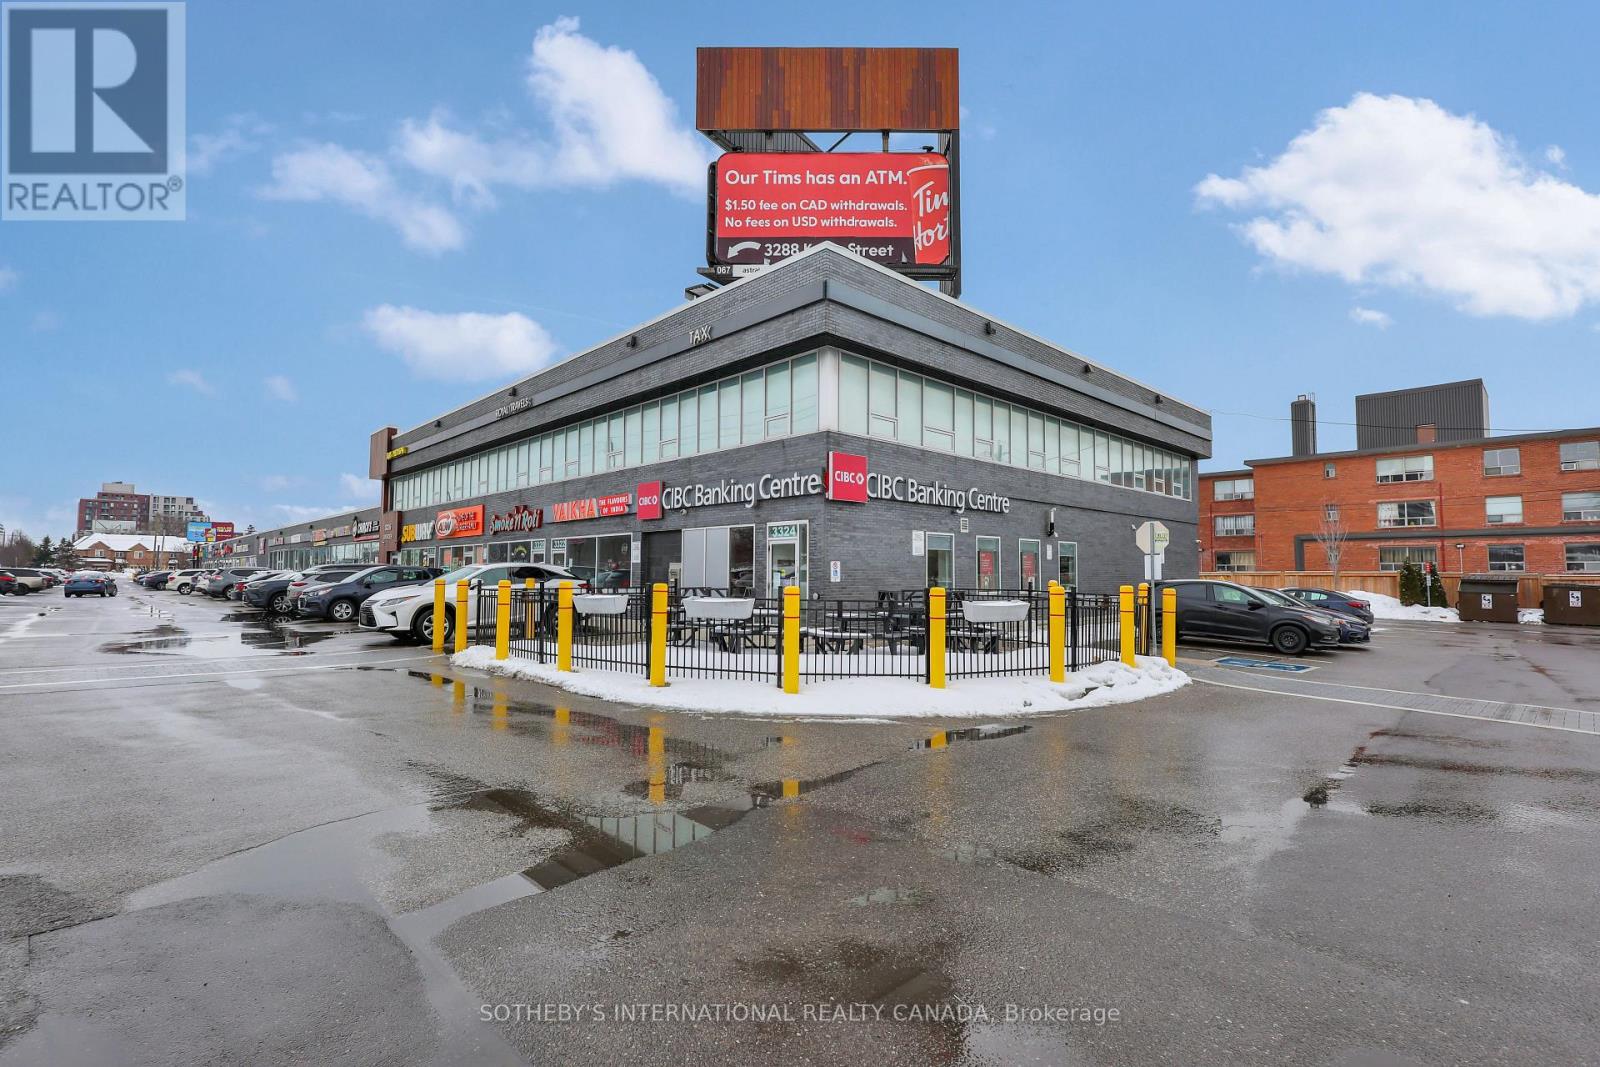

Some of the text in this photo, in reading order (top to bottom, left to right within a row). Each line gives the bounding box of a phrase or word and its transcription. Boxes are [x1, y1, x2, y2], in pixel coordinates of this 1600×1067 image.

[725, 170, 907, 185] Our Tims has an ATM.
[725, 198, 907, 211] $1.50 fee on CAD withdrawals.
[725, 217, 897, 227] No fees on USD withdrawals.
[764, 243, 800, 257] 3288
[848, 243, 894, 257] Street
[716, 266, 731, 274] 067
[835, 471, 855, 484] CIBC
[662, 471, 821, 510] CIBC Banking Centre
[867, 473, 1010, 514] CIBC Banking Centre
[638, 496, 653, 506] CIBC
[402, 520, 435, 543] SUBWAY
[772, 526, 796, 537] 3324
